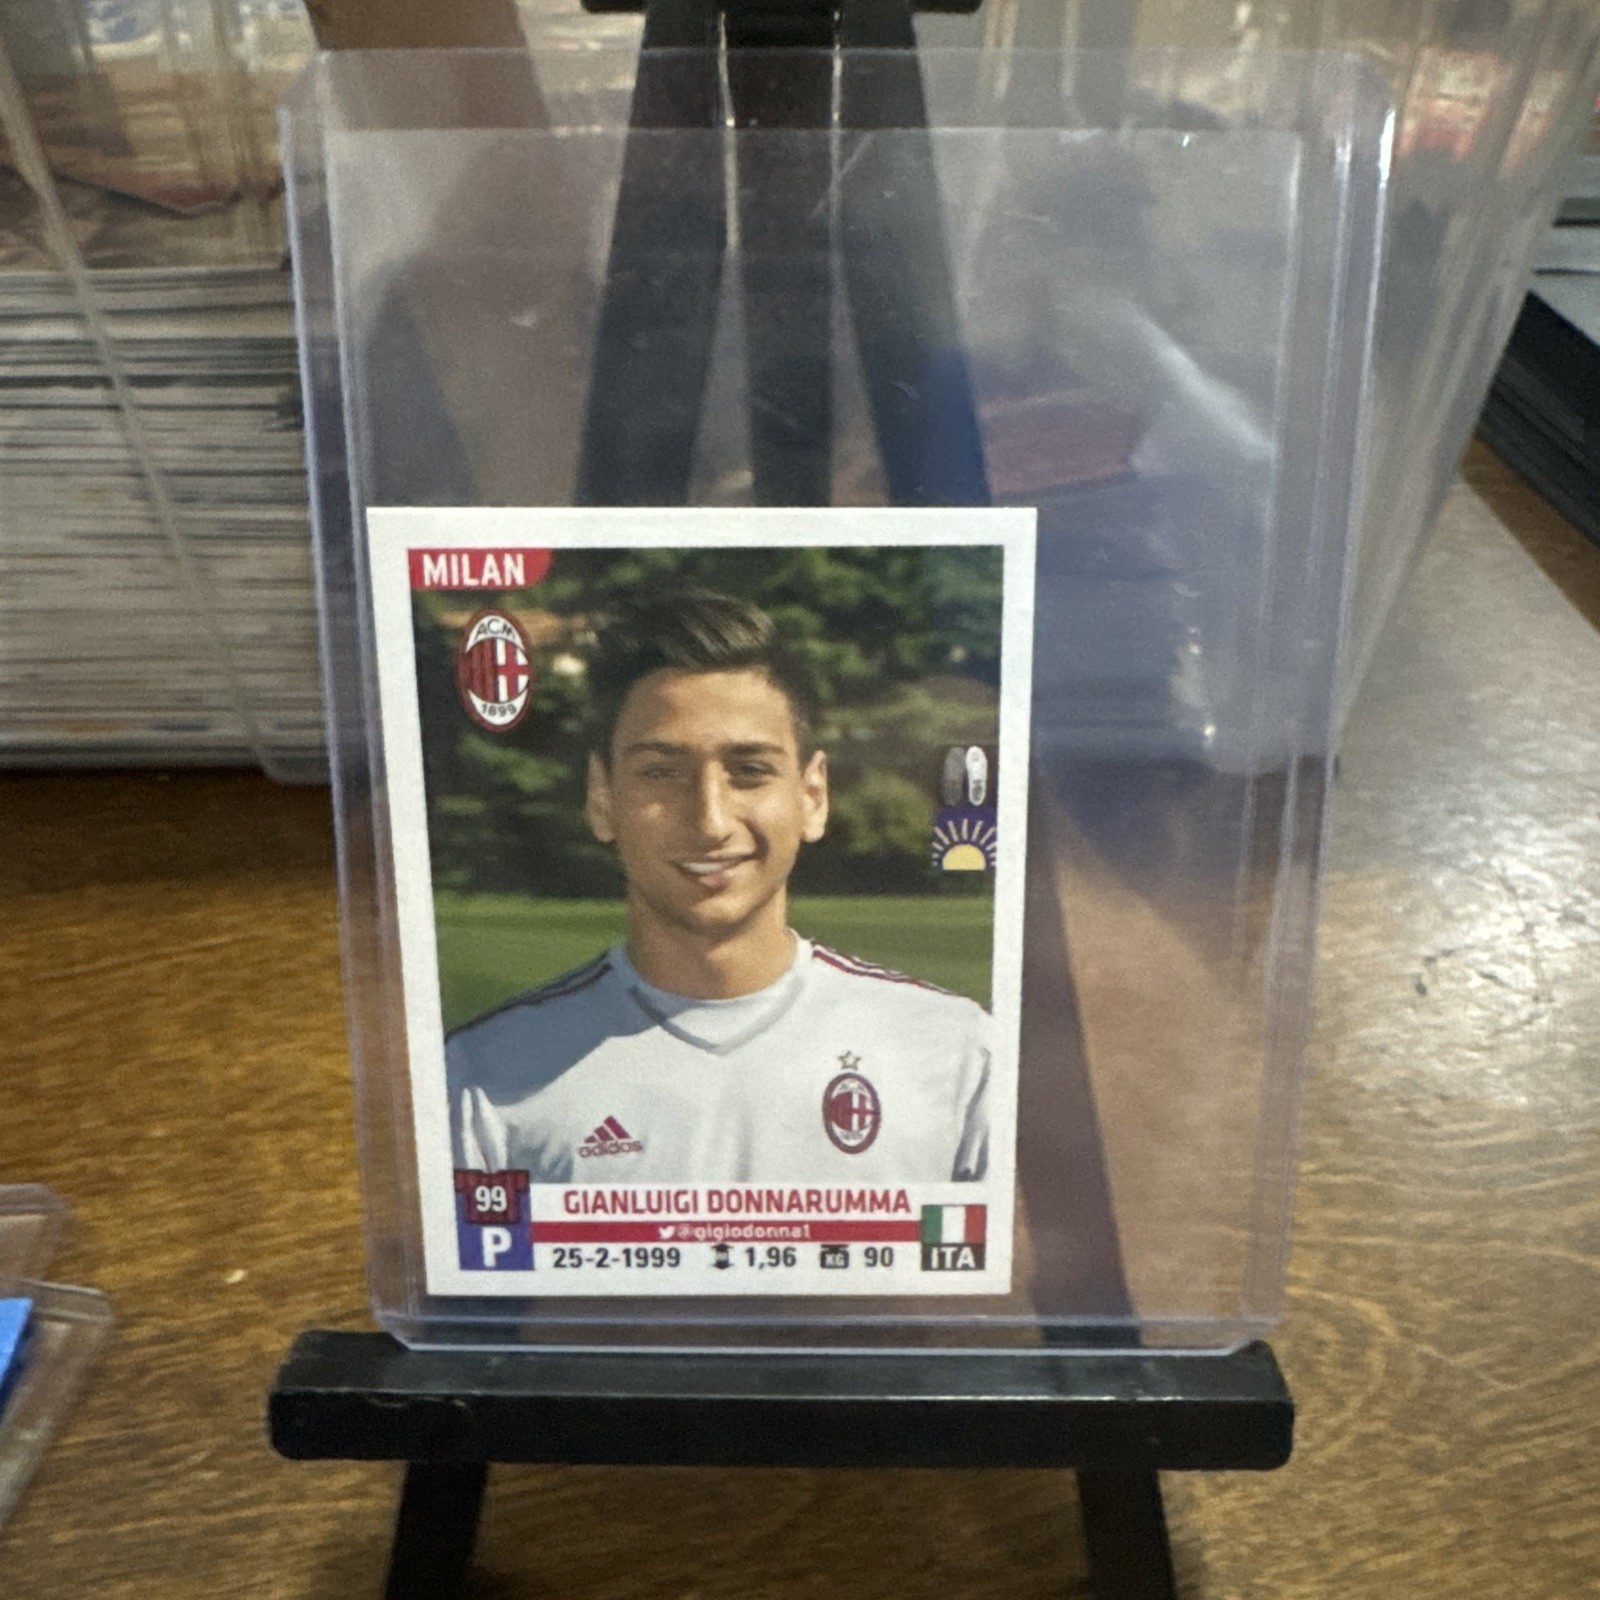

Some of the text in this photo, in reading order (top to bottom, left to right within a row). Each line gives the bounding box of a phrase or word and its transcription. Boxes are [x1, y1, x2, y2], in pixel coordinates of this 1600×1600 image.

[422, 553, 525, 587] MILAN
[476, 618, 515, 638] ACM
[481, 703, 517, 717] 1899
[578, 1139, 644, 1158] adidas
[475, 1185, 507, 1212] 99
[564, 1188, 911, 1214] GIANLUIGI DONNARUMMA
[481, 1226, 512, 1268] P
[553, 1247, 681, 1269] 25-2-1999
[745, 1246, 797, 1269] 1,96
[864, 1247, 894, 1267] 90
[931, 1247, 976, 1270] ITA
